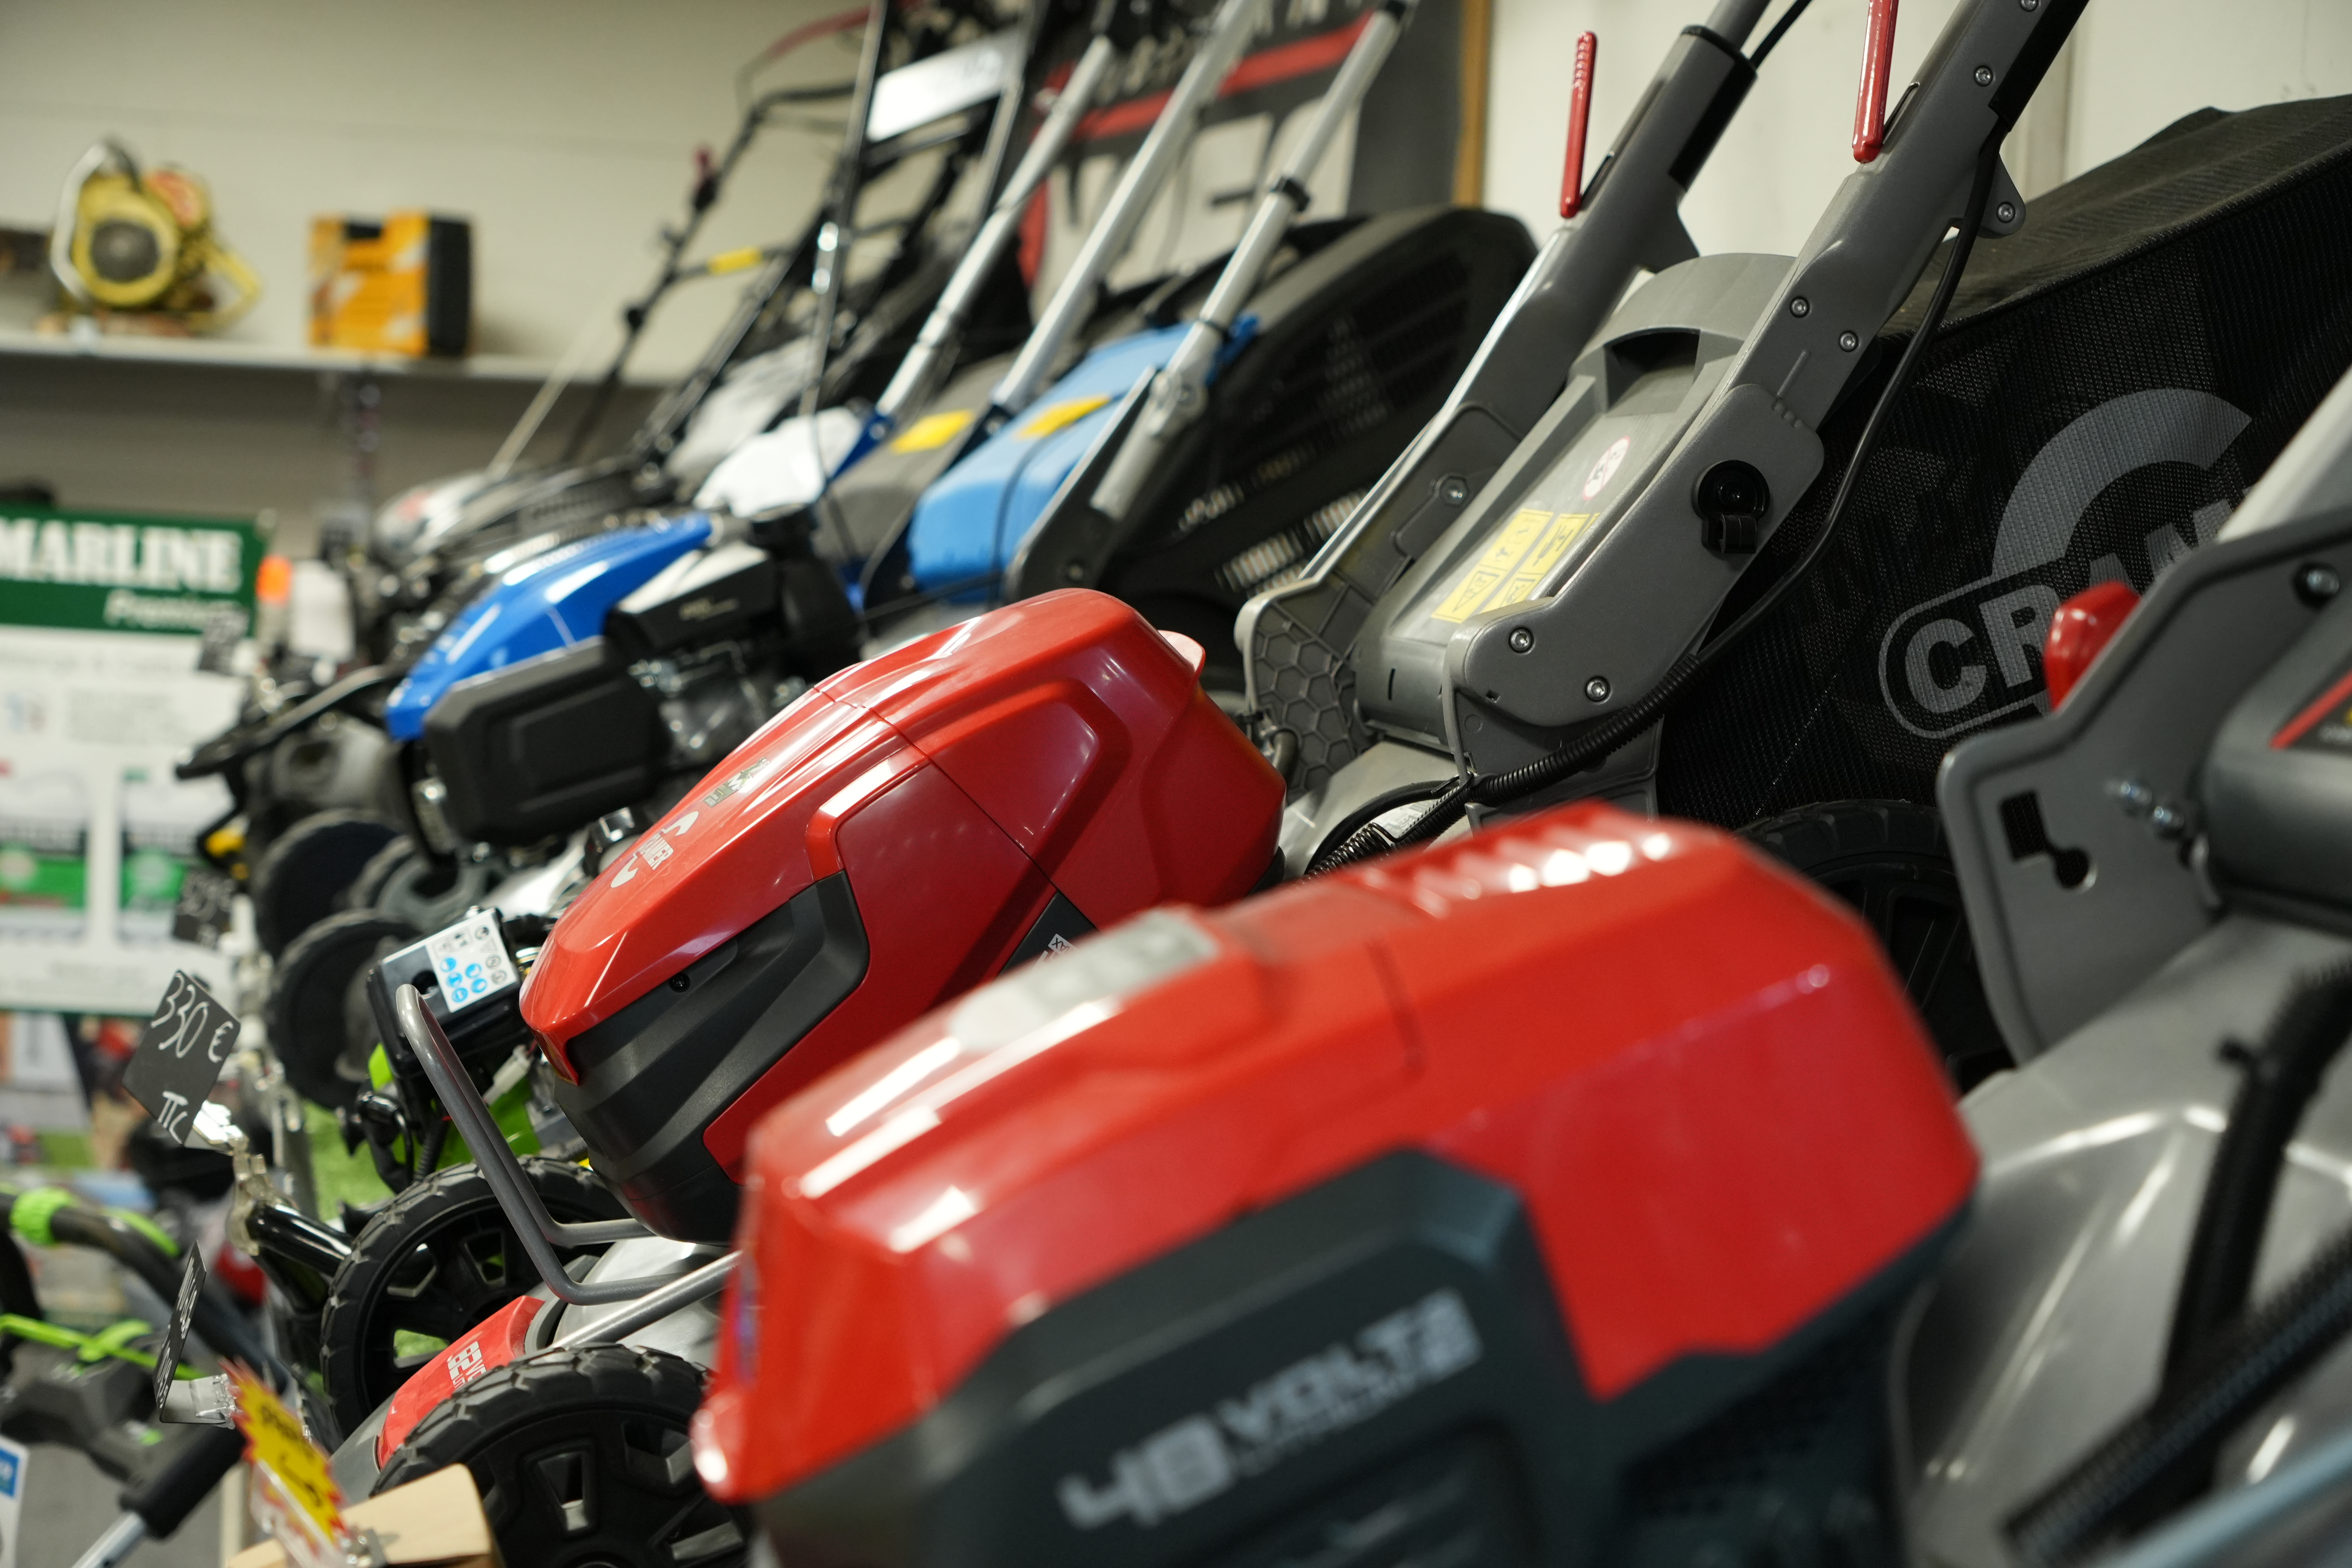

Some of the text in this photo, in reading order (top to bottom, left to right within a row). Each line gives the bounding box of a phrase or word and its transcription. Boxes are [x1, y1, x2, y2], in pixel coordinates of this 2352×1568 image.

[151, 972, 234, 1063] 330 €
[447, 1341, 482, 1380] 82
